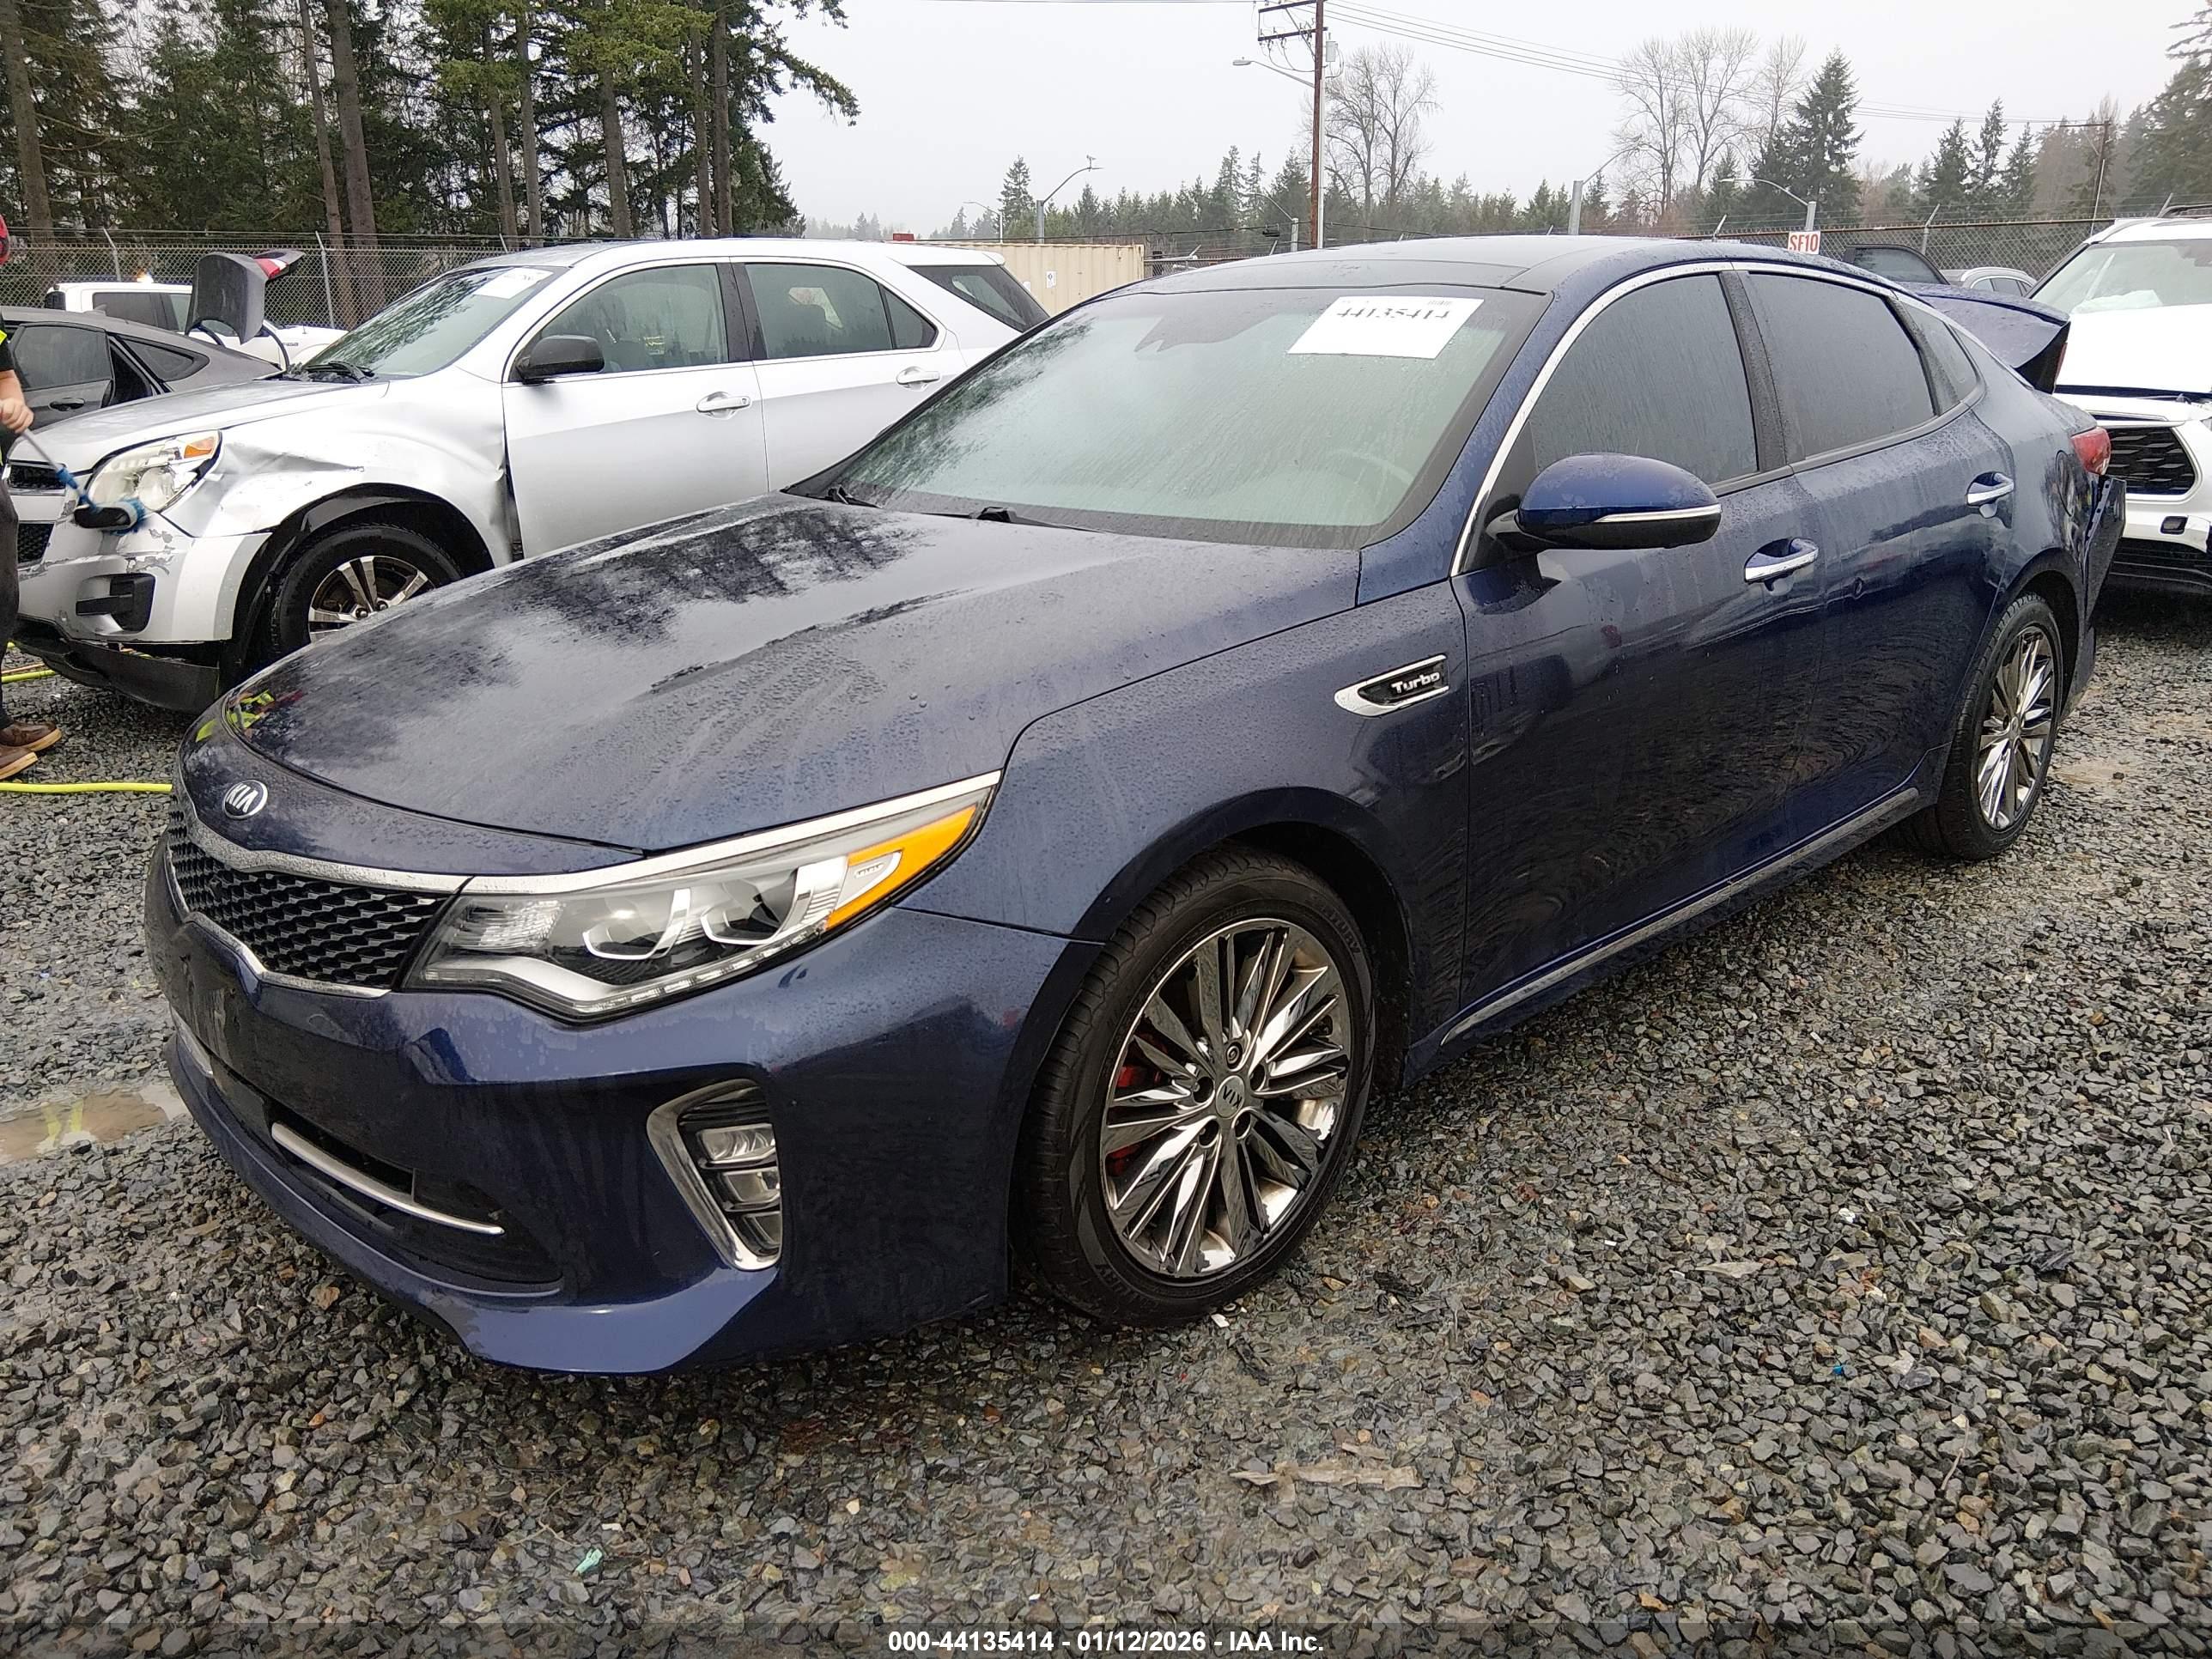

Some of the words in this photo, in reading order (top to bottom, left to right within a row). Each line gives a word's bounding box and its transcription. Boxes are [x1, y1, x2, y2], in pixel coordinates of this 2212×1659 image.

[1790, 234, 1819, 252] SF10
[1391, 672, 1440, 694] Turbo
[226, 782, 258, 813] KIA
[1223, 1085, 1243, 1109] KIA
